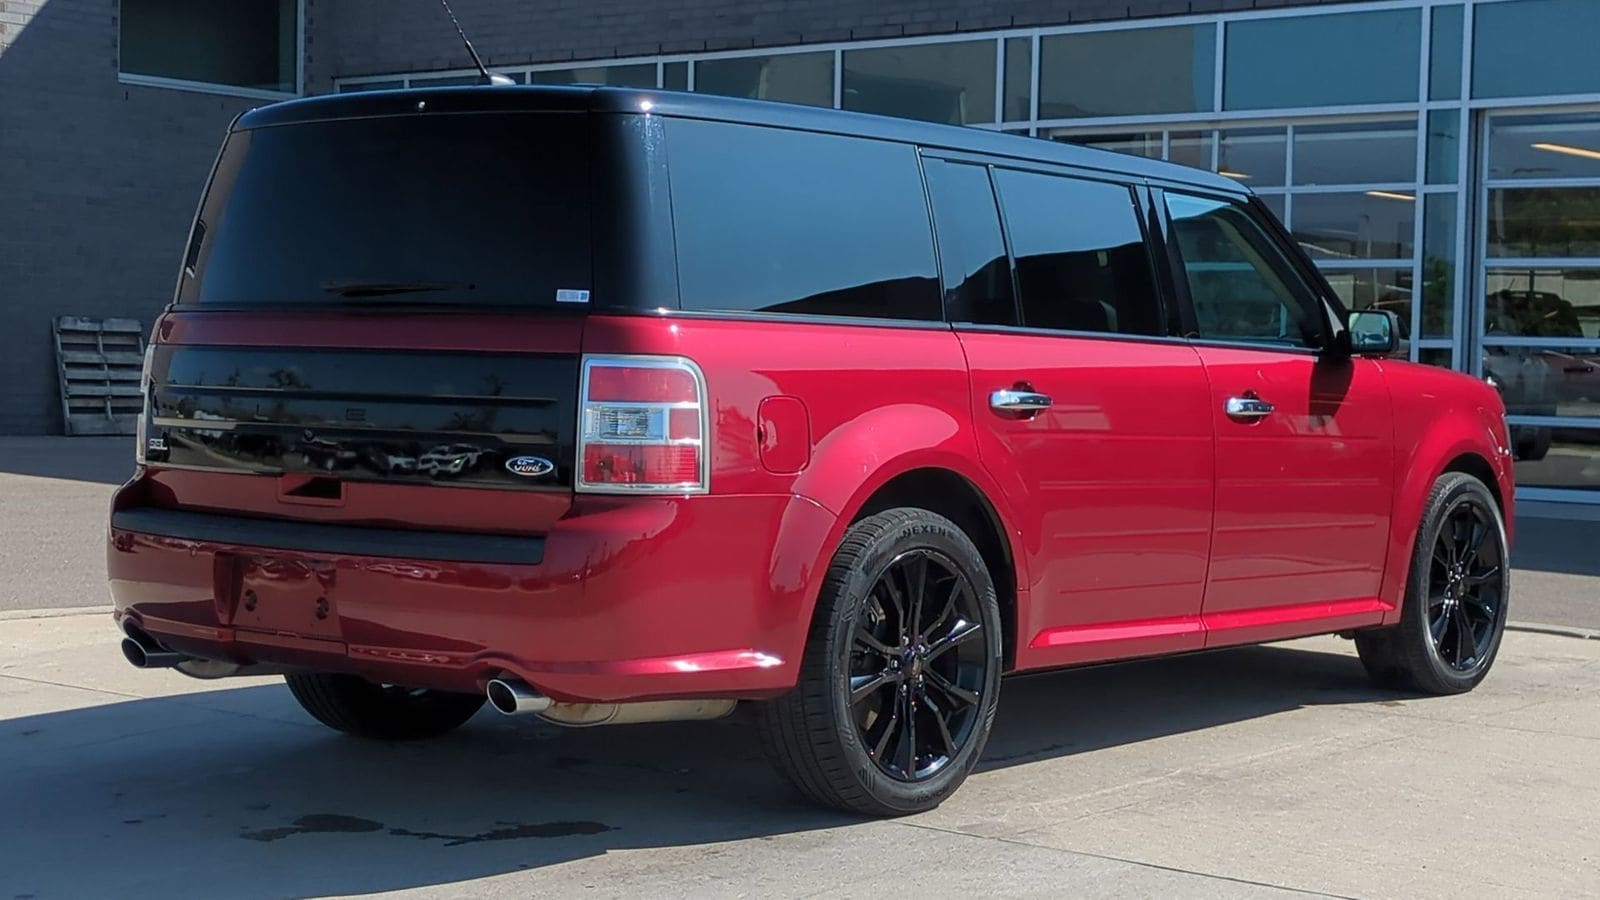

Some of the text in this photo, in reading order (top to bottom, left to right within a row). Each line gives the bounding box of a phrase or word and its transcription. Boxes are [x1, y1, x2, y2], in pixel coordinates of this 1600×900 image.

[149, 438, 168, 450] SEL
[513, 457, 543, 473] Ford
[903, 524, 946, 537] NEXEN
